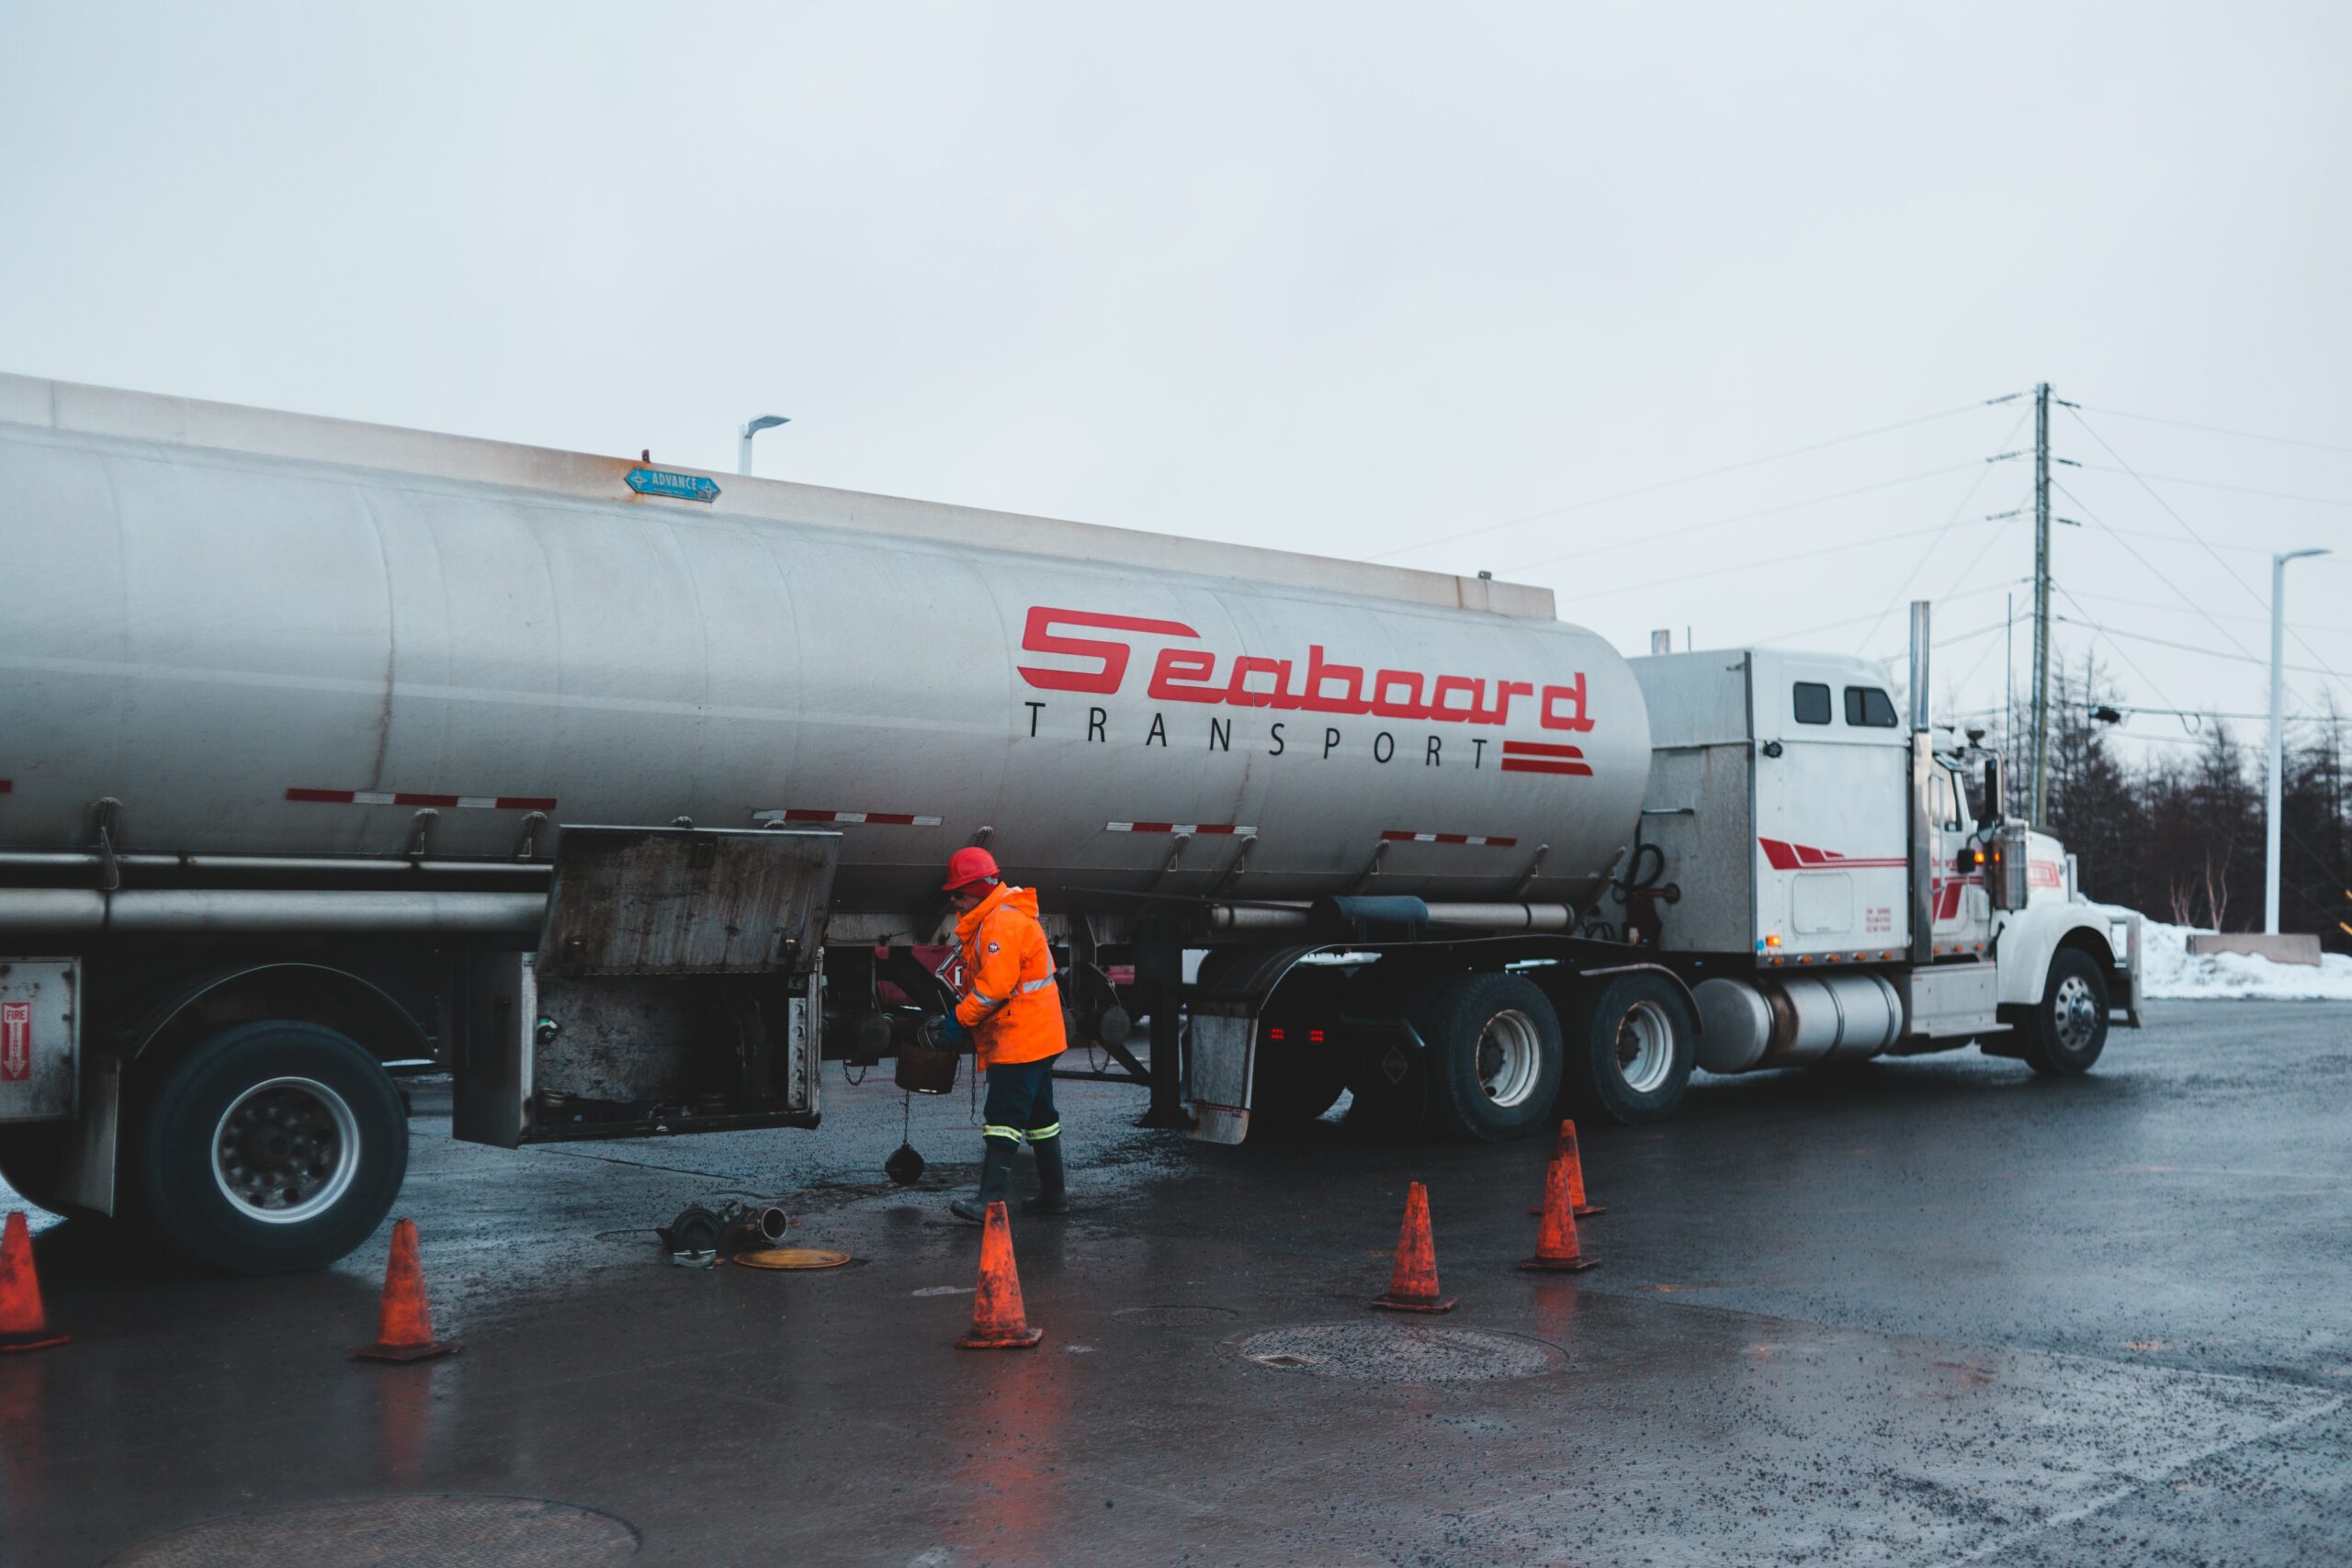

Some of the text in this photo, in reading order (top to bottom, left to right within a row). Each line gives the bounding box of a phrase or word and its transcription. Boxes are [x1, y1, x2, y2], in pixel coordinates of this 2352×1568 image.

[652, 472, 697, 491] ADVANCE
[1017, 606, 1595, 732] Seaboard
[1024, 702, 1487, 769] TRANSPORT
[6, 1010, 26, 1021] FIRE
